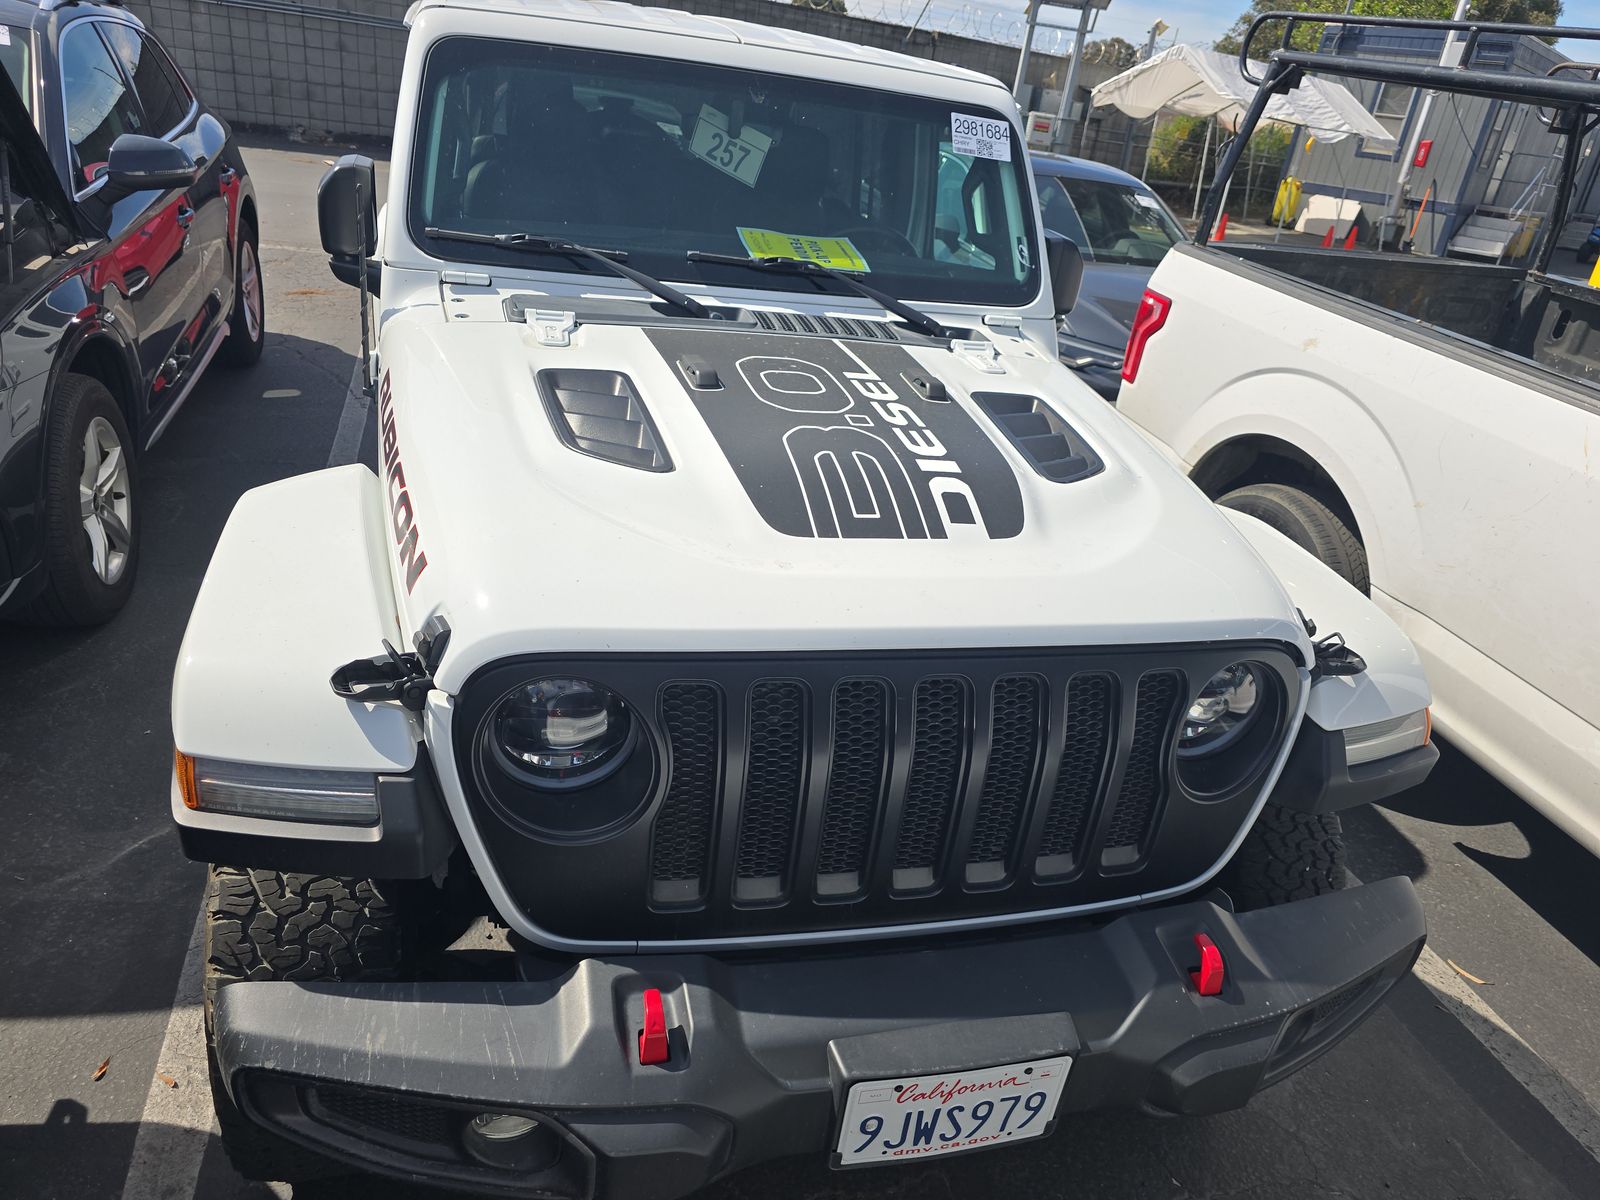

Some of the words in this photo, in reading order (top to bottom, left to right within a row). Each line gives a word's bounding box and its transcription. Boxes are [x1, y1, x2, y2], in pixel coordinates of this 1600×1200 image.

[705, 132, 751, 173] 257
[954, 118, 1009, 141] 2981684
[735, 356, 931, 539] 3.0
[832, 339, 990, 539] DIESEL
[380, 367, 428, 597] RUBICON
[896, 1074, 1030, 1104] California
[854, 1091, 1047, 1153] 9JWS979
[892, 1133, 1001, 1156] dmv.ca.gov
